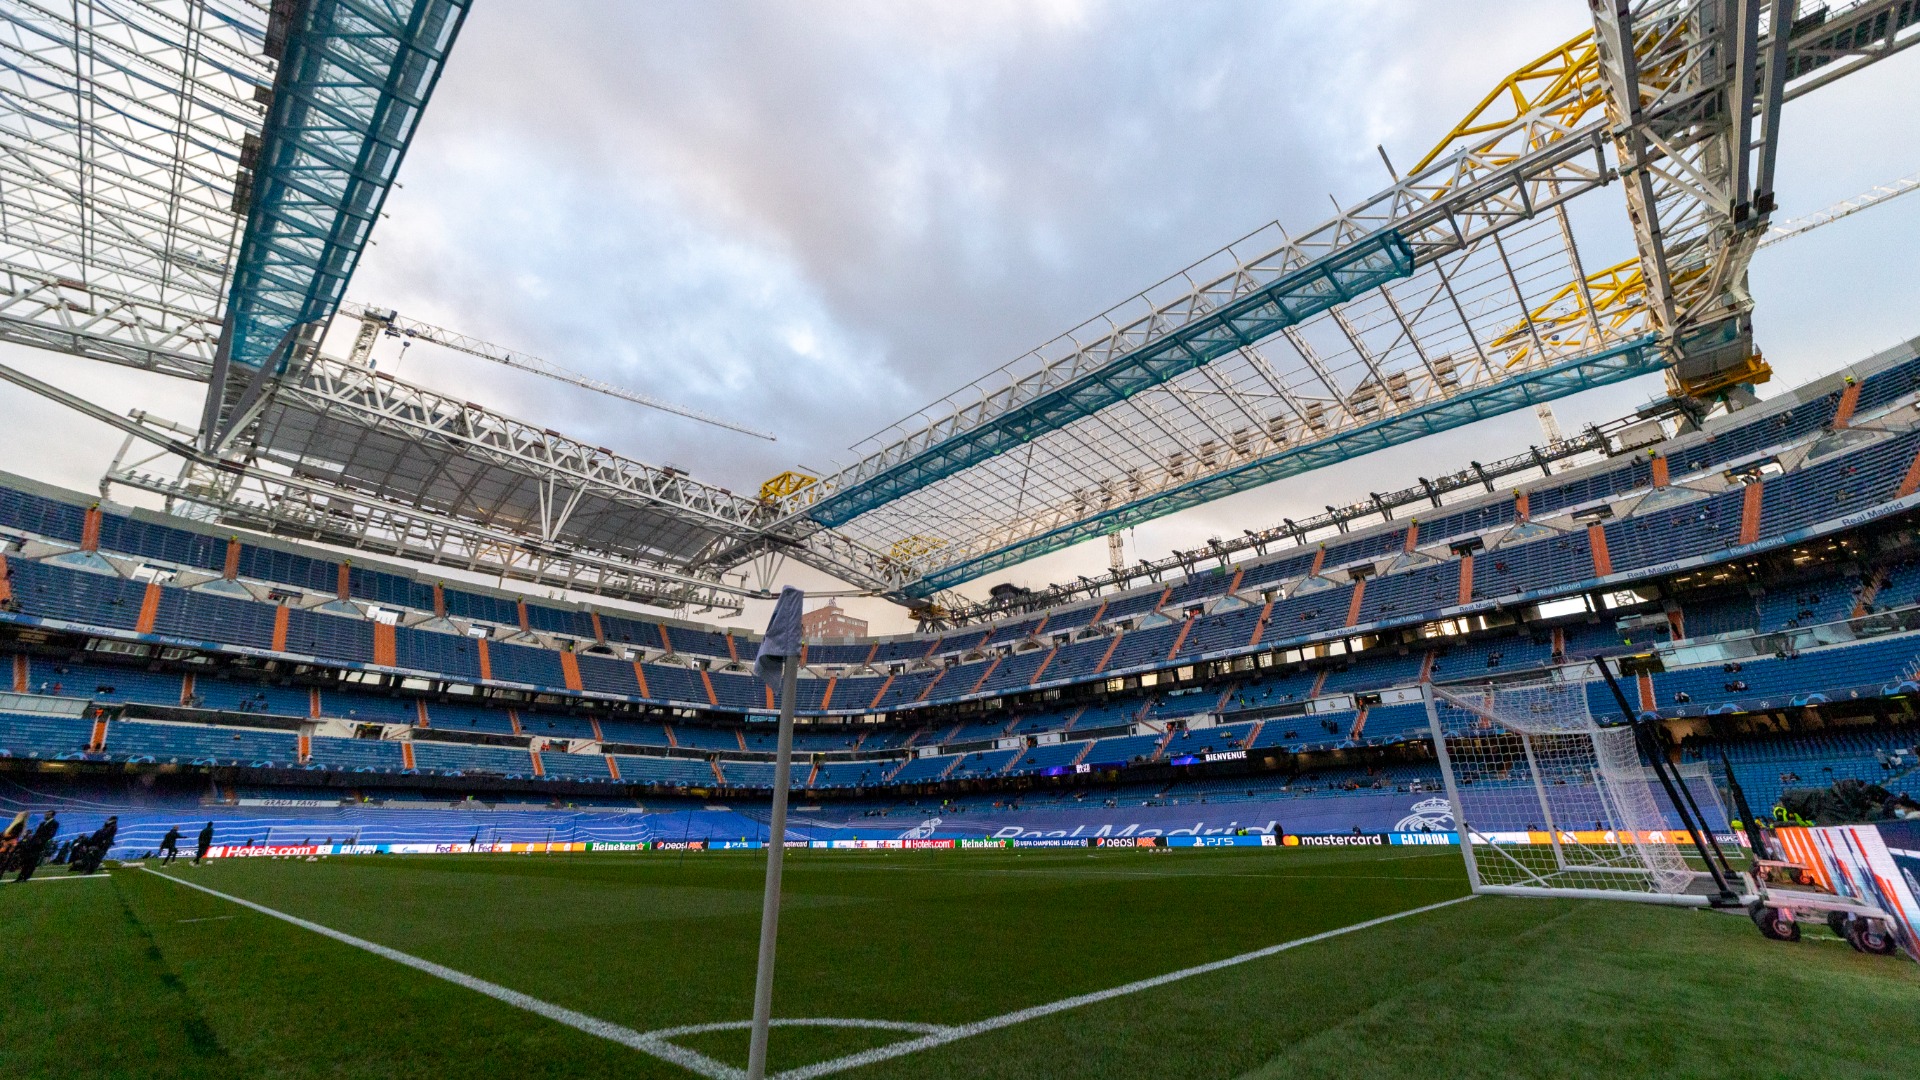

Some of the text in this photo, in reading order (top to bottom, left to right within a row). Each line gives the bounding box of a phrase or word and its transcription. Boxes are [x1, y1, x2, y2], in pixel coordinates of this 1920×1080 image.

[1842, 502, 1904, 526] Real Madrid
[1730, 536, 1785, 556] Real Madrid
[1627, 563, 1680, 579] Real Madrid
[1537, 583, 1581, 597] Real Madrid
[1475, 600, 1497, 609] Madri
[1205, 750, 1247, 762] BIENVENUE
[912, 840, 951, 849] Hotels.com
[961, 838, 999, 848] Heineken
[1106, 837, 1135, 847] pepsi
[1206, 837, 1234, 846] PS5
[1302, 833, 1381, 846] mastercard
[1401, 833, 1449, 845] GAZPROM
[226, 845, 310, 857] Hotels.com
[435, 844, 462, 853] FedEx
[478, 843, 503, 853] FedEx
[592, 842, 636, 851] Heineken
